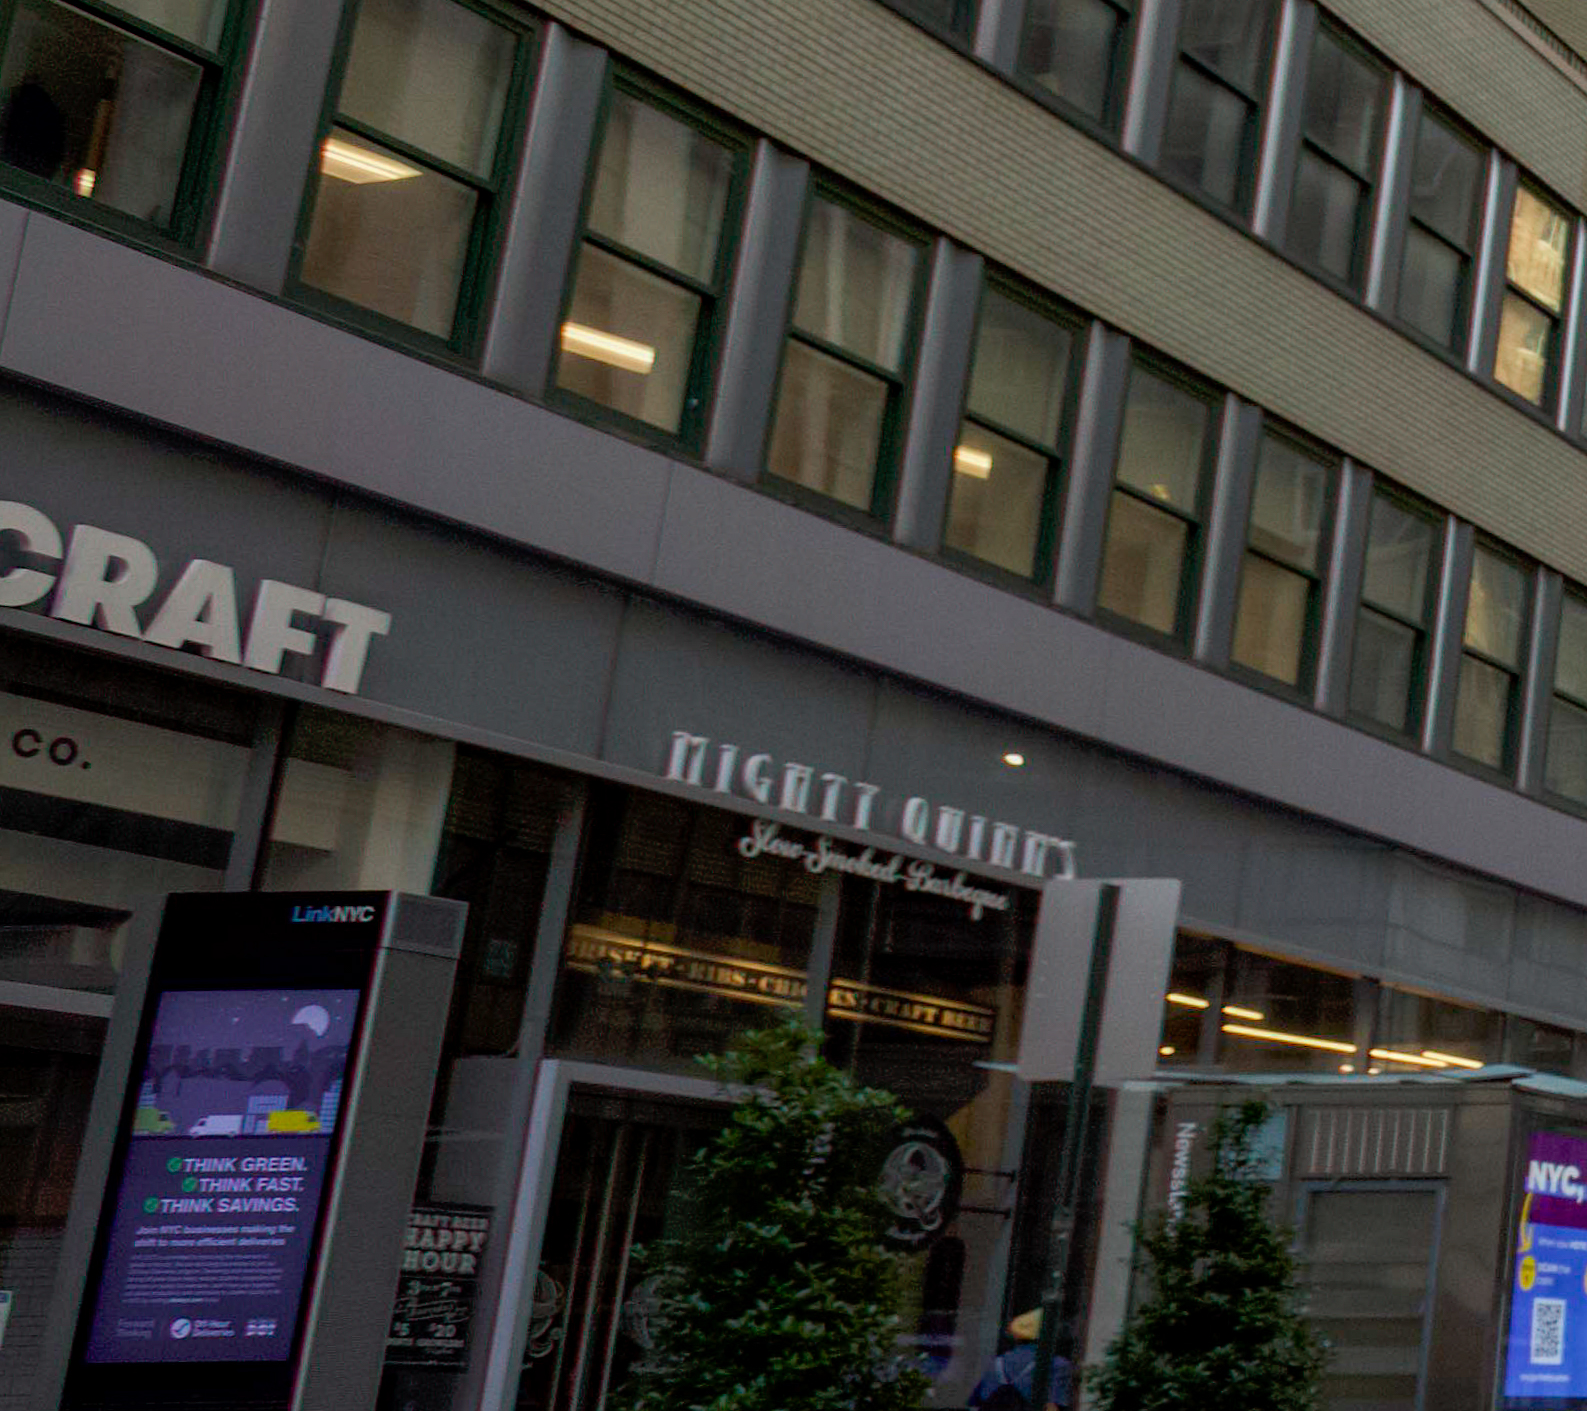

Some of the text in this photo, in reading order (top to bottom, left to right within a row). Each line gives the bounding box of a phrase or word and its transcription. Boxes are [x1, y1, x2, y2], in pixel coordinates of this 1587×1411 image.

[0, 500, 392, 694] CRAFT
[12, 729, 91, 769] CO.
[667, 731, 880, 830] MIGHTY
[291, 905, 376, 923] LinkNYC
[183, 1156, 308, 1172] THINK GREEN.
[199, 1176, 305, 1192] THINK FAST.
[1528, 1160, 1584, 1204] NYC,
[160, 1196, 300, 1214] THINK SAVINGS.
[402, 1249, 478, 1275] HOUR
